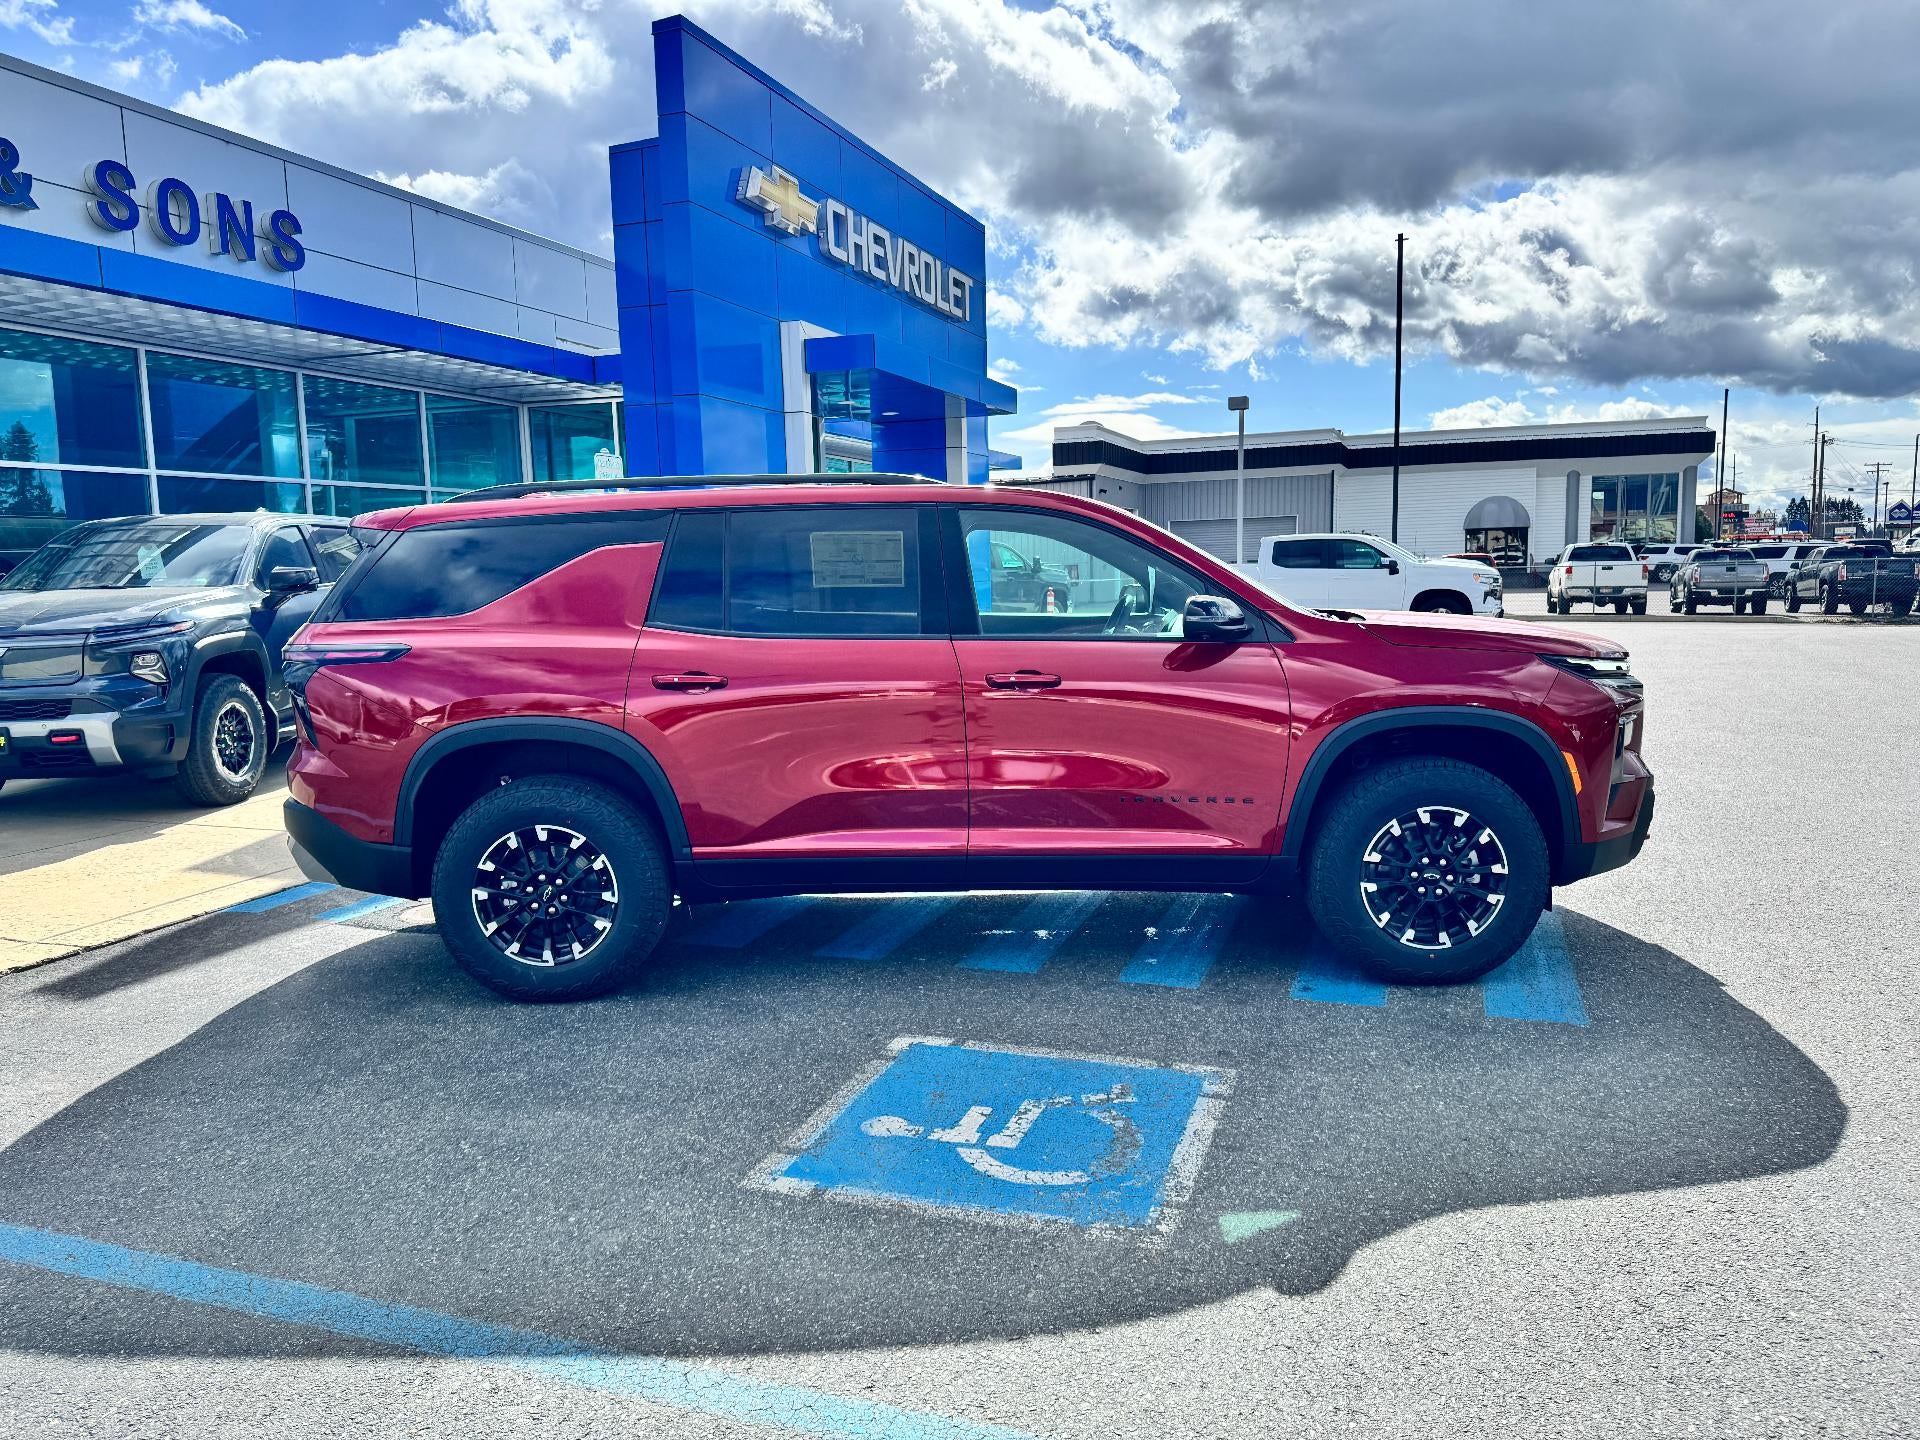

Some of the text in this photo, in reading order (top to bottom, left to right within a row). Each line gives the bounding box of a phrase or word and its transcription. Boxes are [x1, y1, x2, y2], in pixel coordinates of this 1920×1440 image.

[0, 137, 305, 273] & SONS
[824, 198, 973, 322] CHEVROLET
[1119, 796, 1254, 804] TRAVERSE
